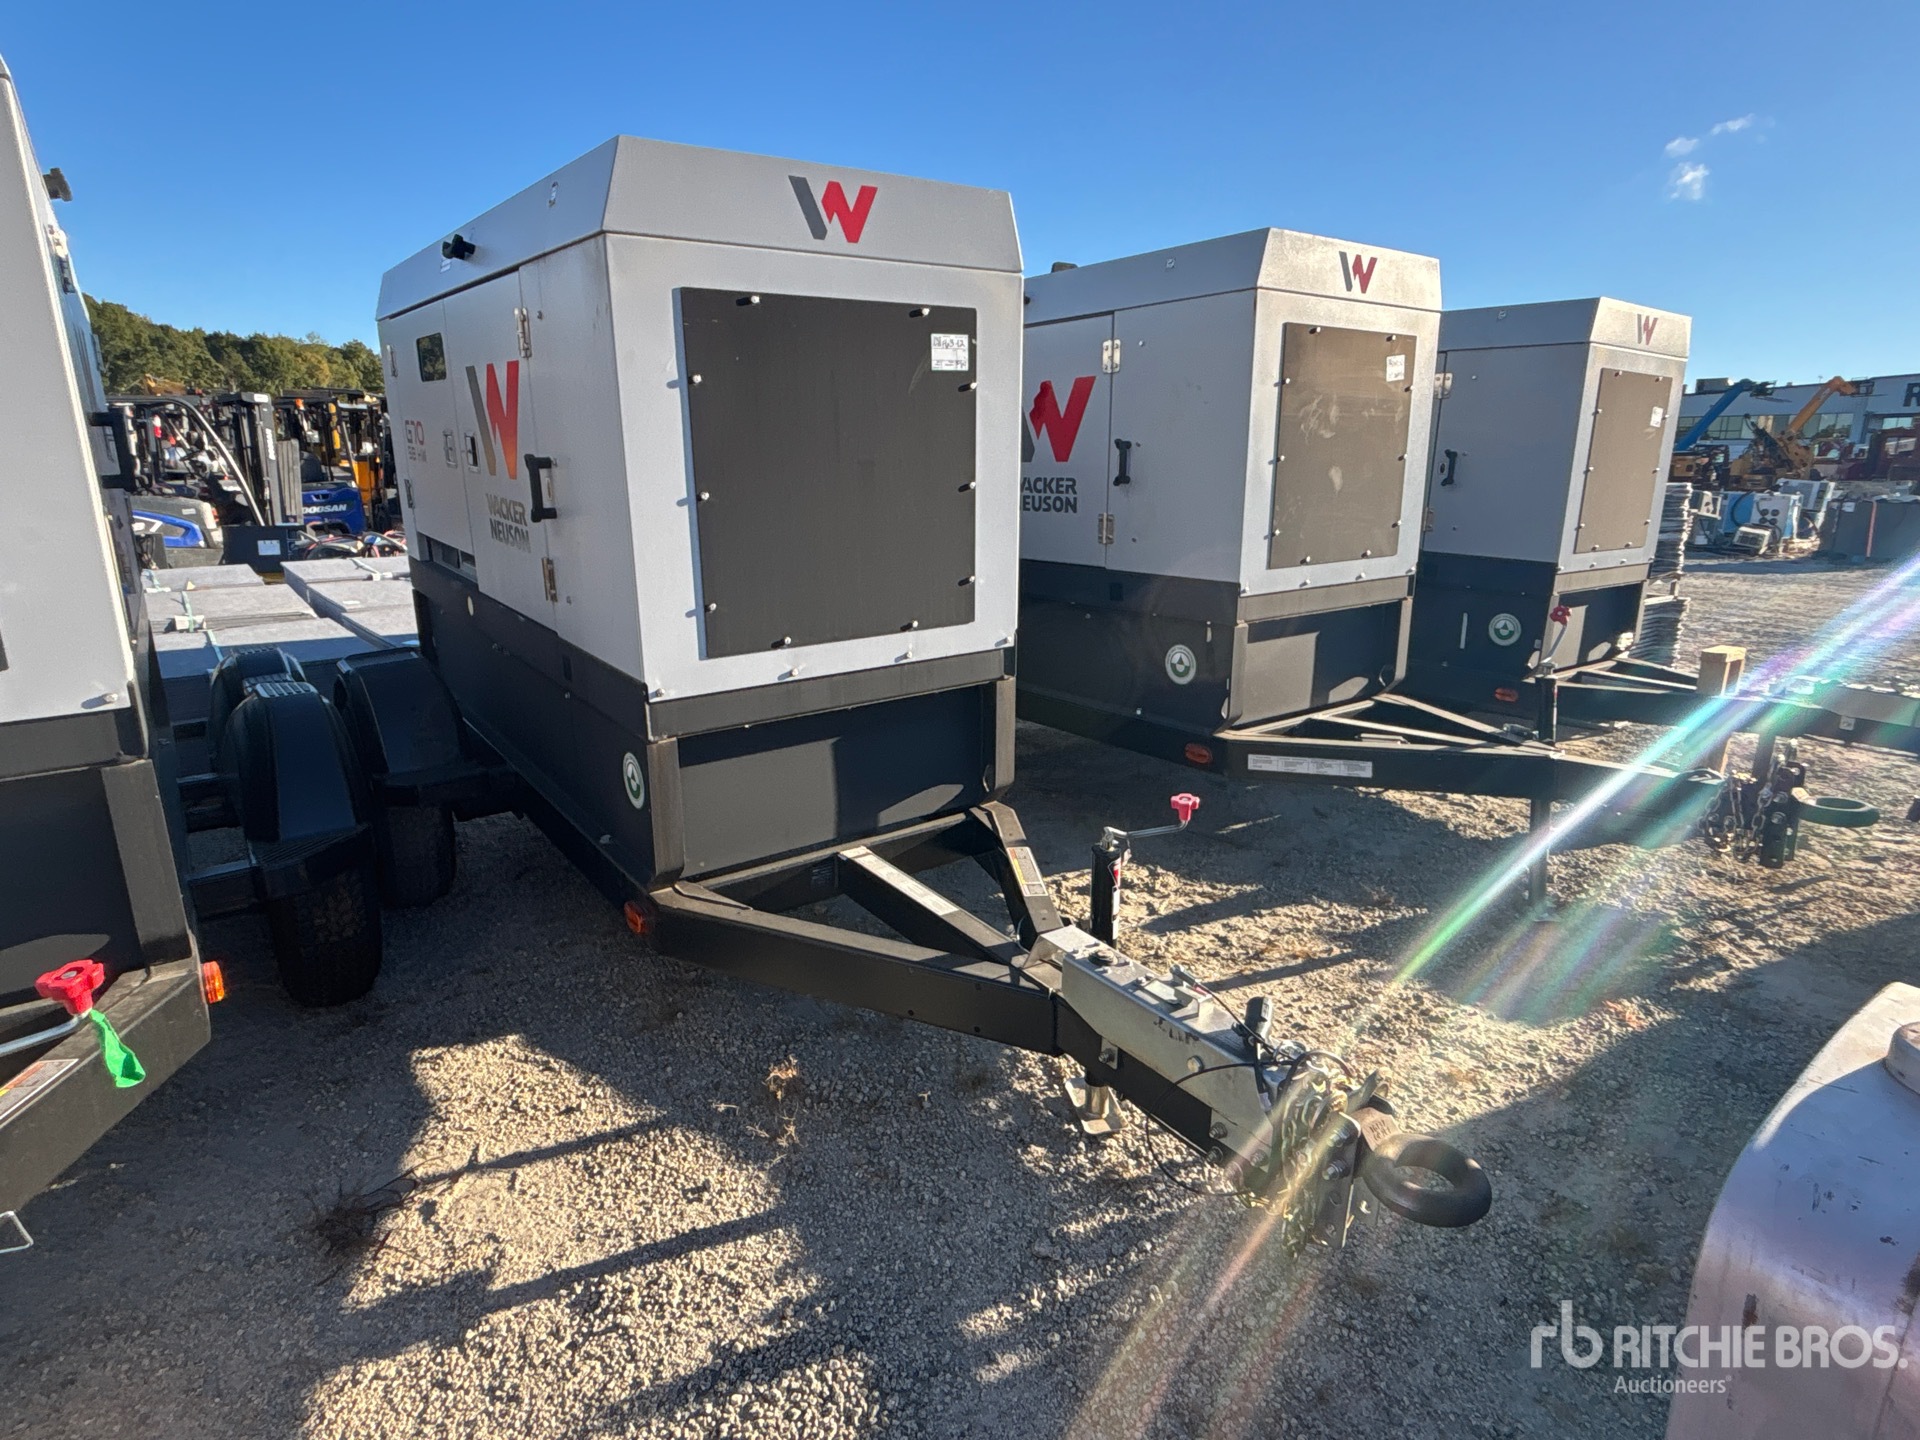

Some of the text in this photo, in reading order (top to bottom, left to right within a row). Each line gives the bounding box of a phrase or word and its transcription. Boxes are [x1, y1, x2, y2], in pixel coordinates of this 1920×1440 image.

[485, 493, 528, 527] WACKER
[1021, 495, 1078, 514] EUSON
[489, 517, 531, 554] NEUSON
